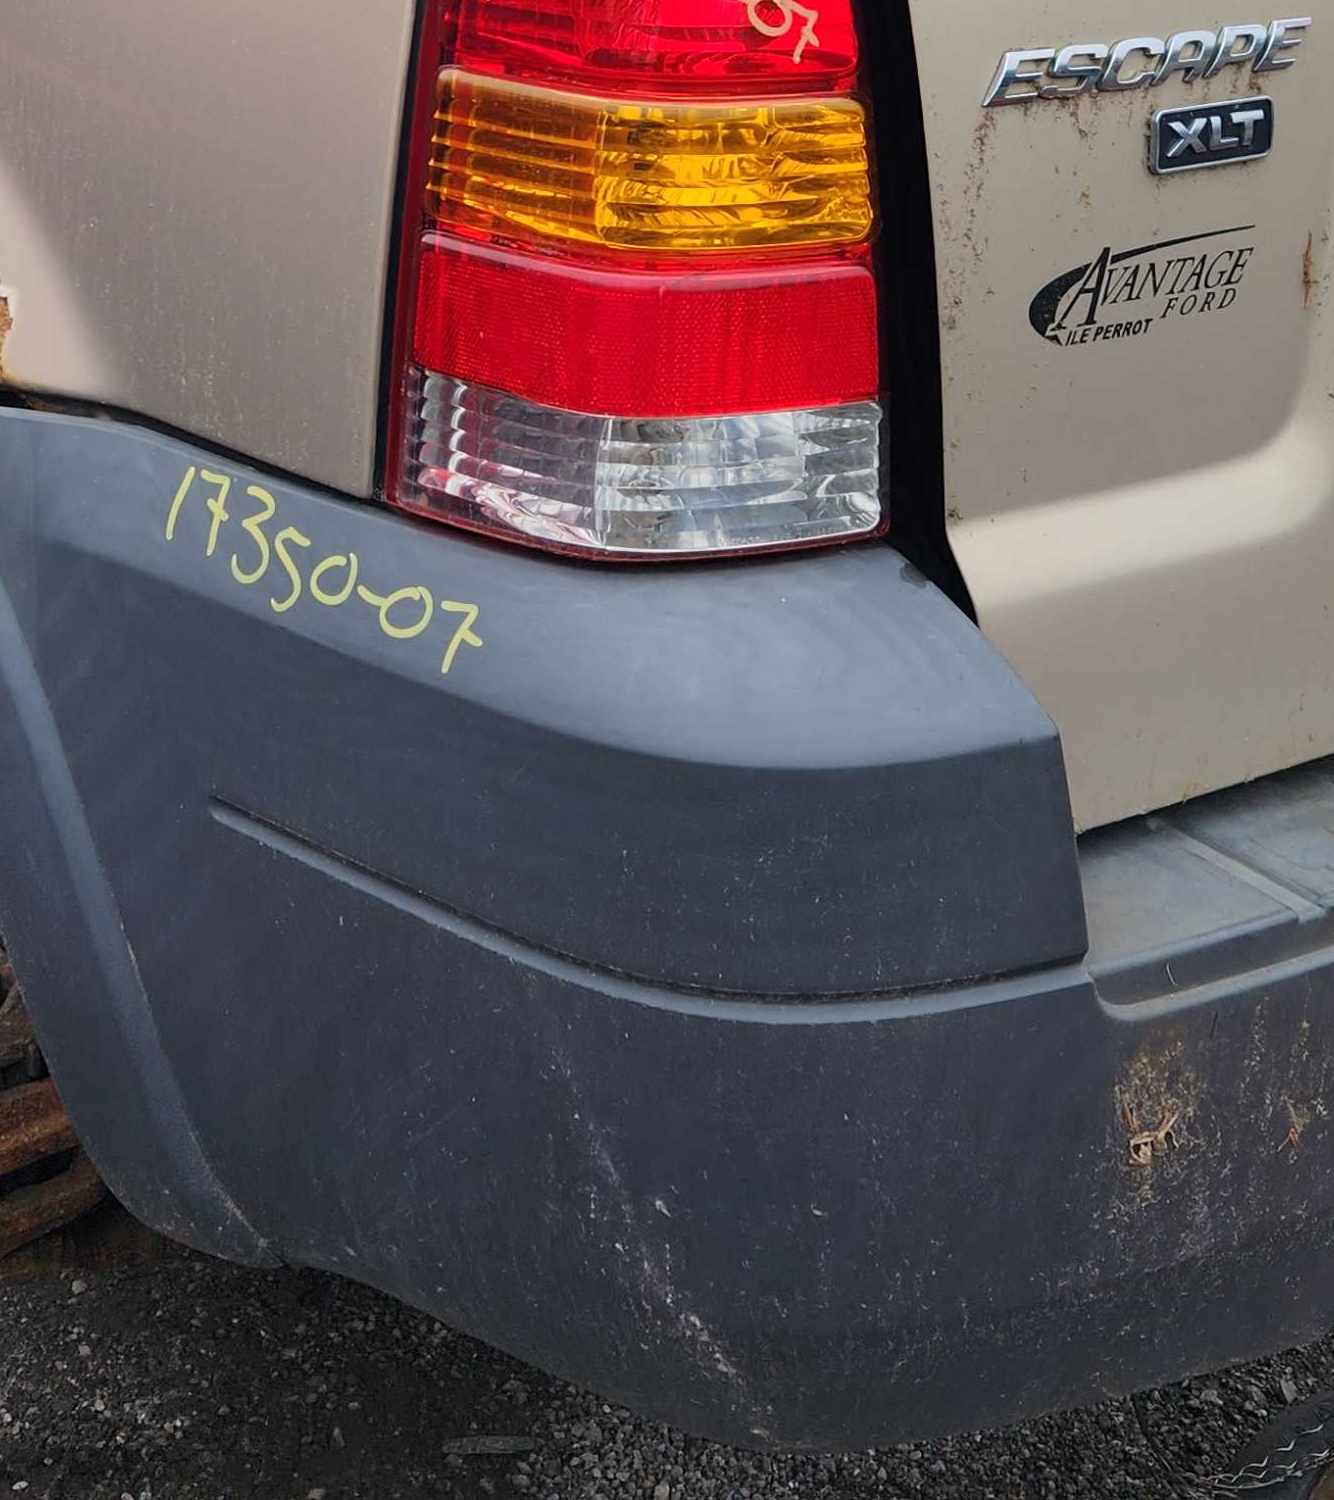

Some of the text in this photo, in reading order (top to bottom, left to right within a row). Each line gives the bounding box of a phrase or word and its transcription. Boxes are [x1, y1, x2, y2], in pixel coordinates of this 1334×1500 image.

[982, 16, 1313, 108] ESCAPE
[1166, 109, 1265, 159] XLT
[1050, 246, 1255, 332] AVANTAGE
[1160, 287, 1236, 319] FORD
[1092, 317, 1154, 342] PERROT
[164, 466, 484, 675] 17350-07
